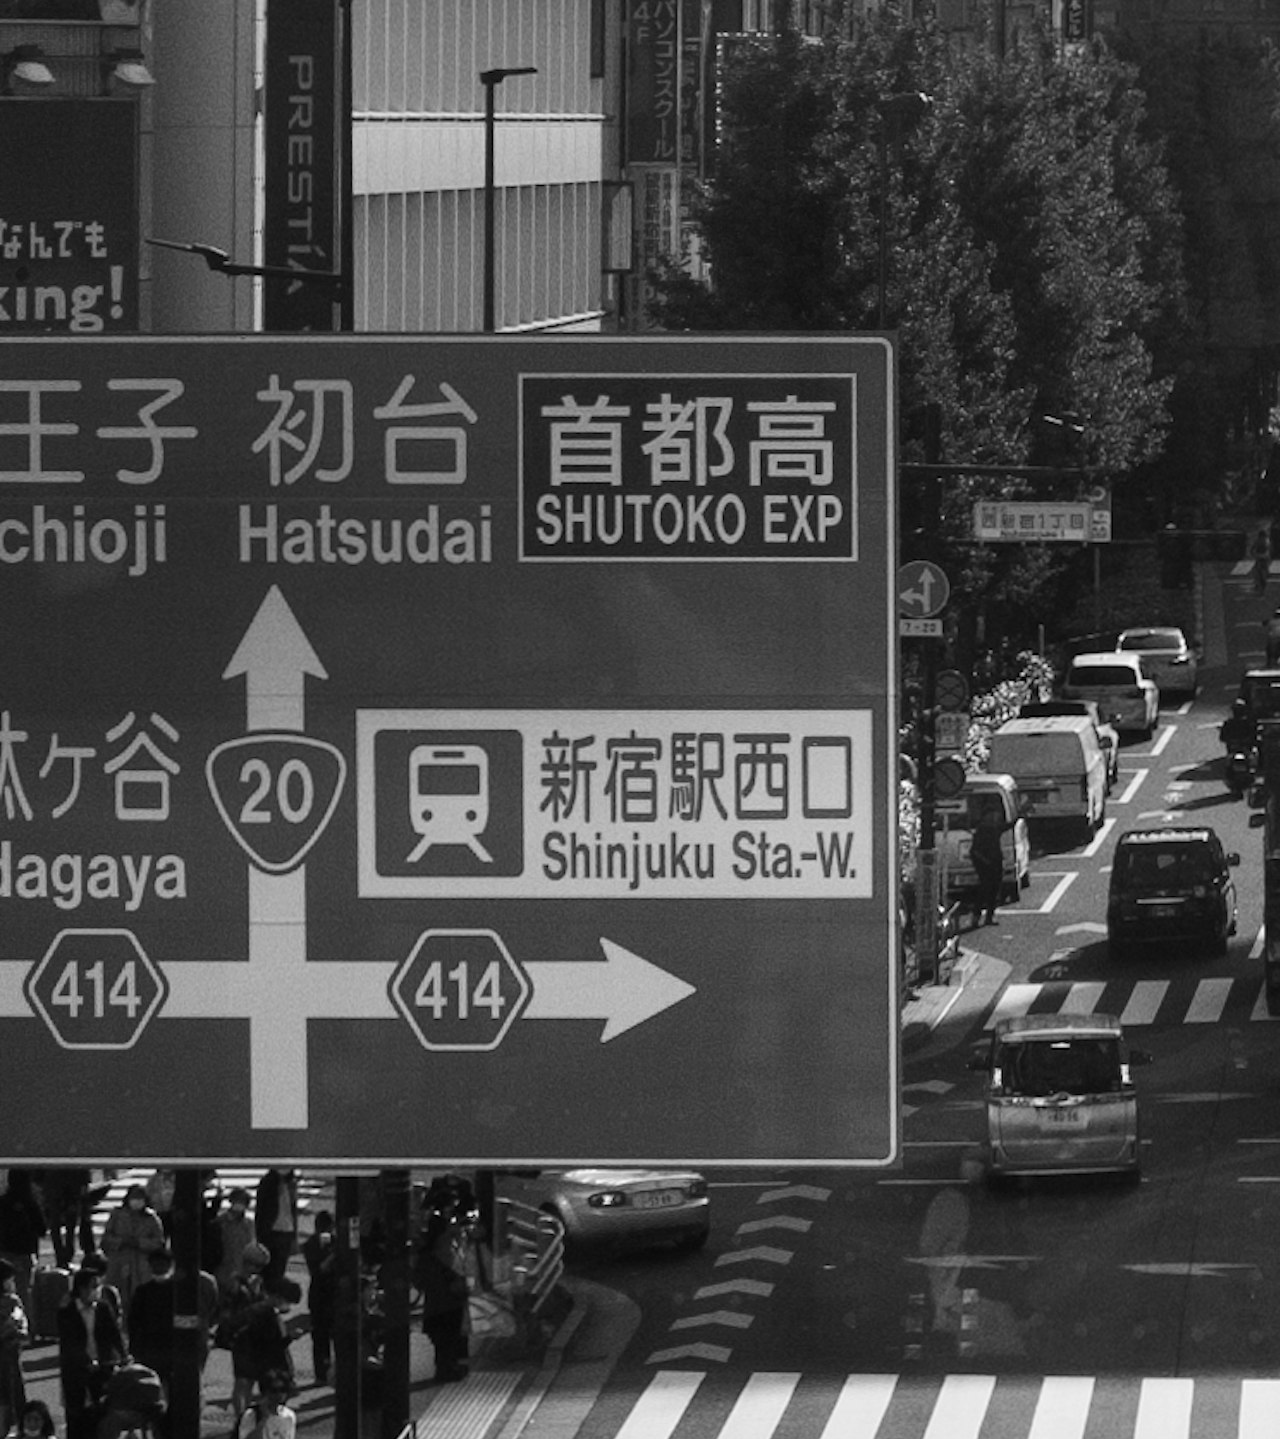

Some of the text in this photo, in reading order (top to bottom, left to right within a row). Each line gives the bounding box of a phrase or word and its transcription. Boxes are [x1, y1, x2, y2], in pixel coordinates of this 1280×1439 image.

[251, 373, 479, 488] 初台
[539, 395, 838, 488] 首都高
[238, 506, 493, 563] Hatsudai
[536, 494, 746, 546] SHUTOKO
[764, 496, 844, 545] EXP
[239, 757, 314, 826] 20
[539, 731, 853, 824] 新宿駅西口
[0, 842, 188, 911] agaya
[541, 831, 858, 891] Shinjuku Sta.-W.
[50, 960, 142, 1019] 414
[413, 960, 507, 1020] 414
